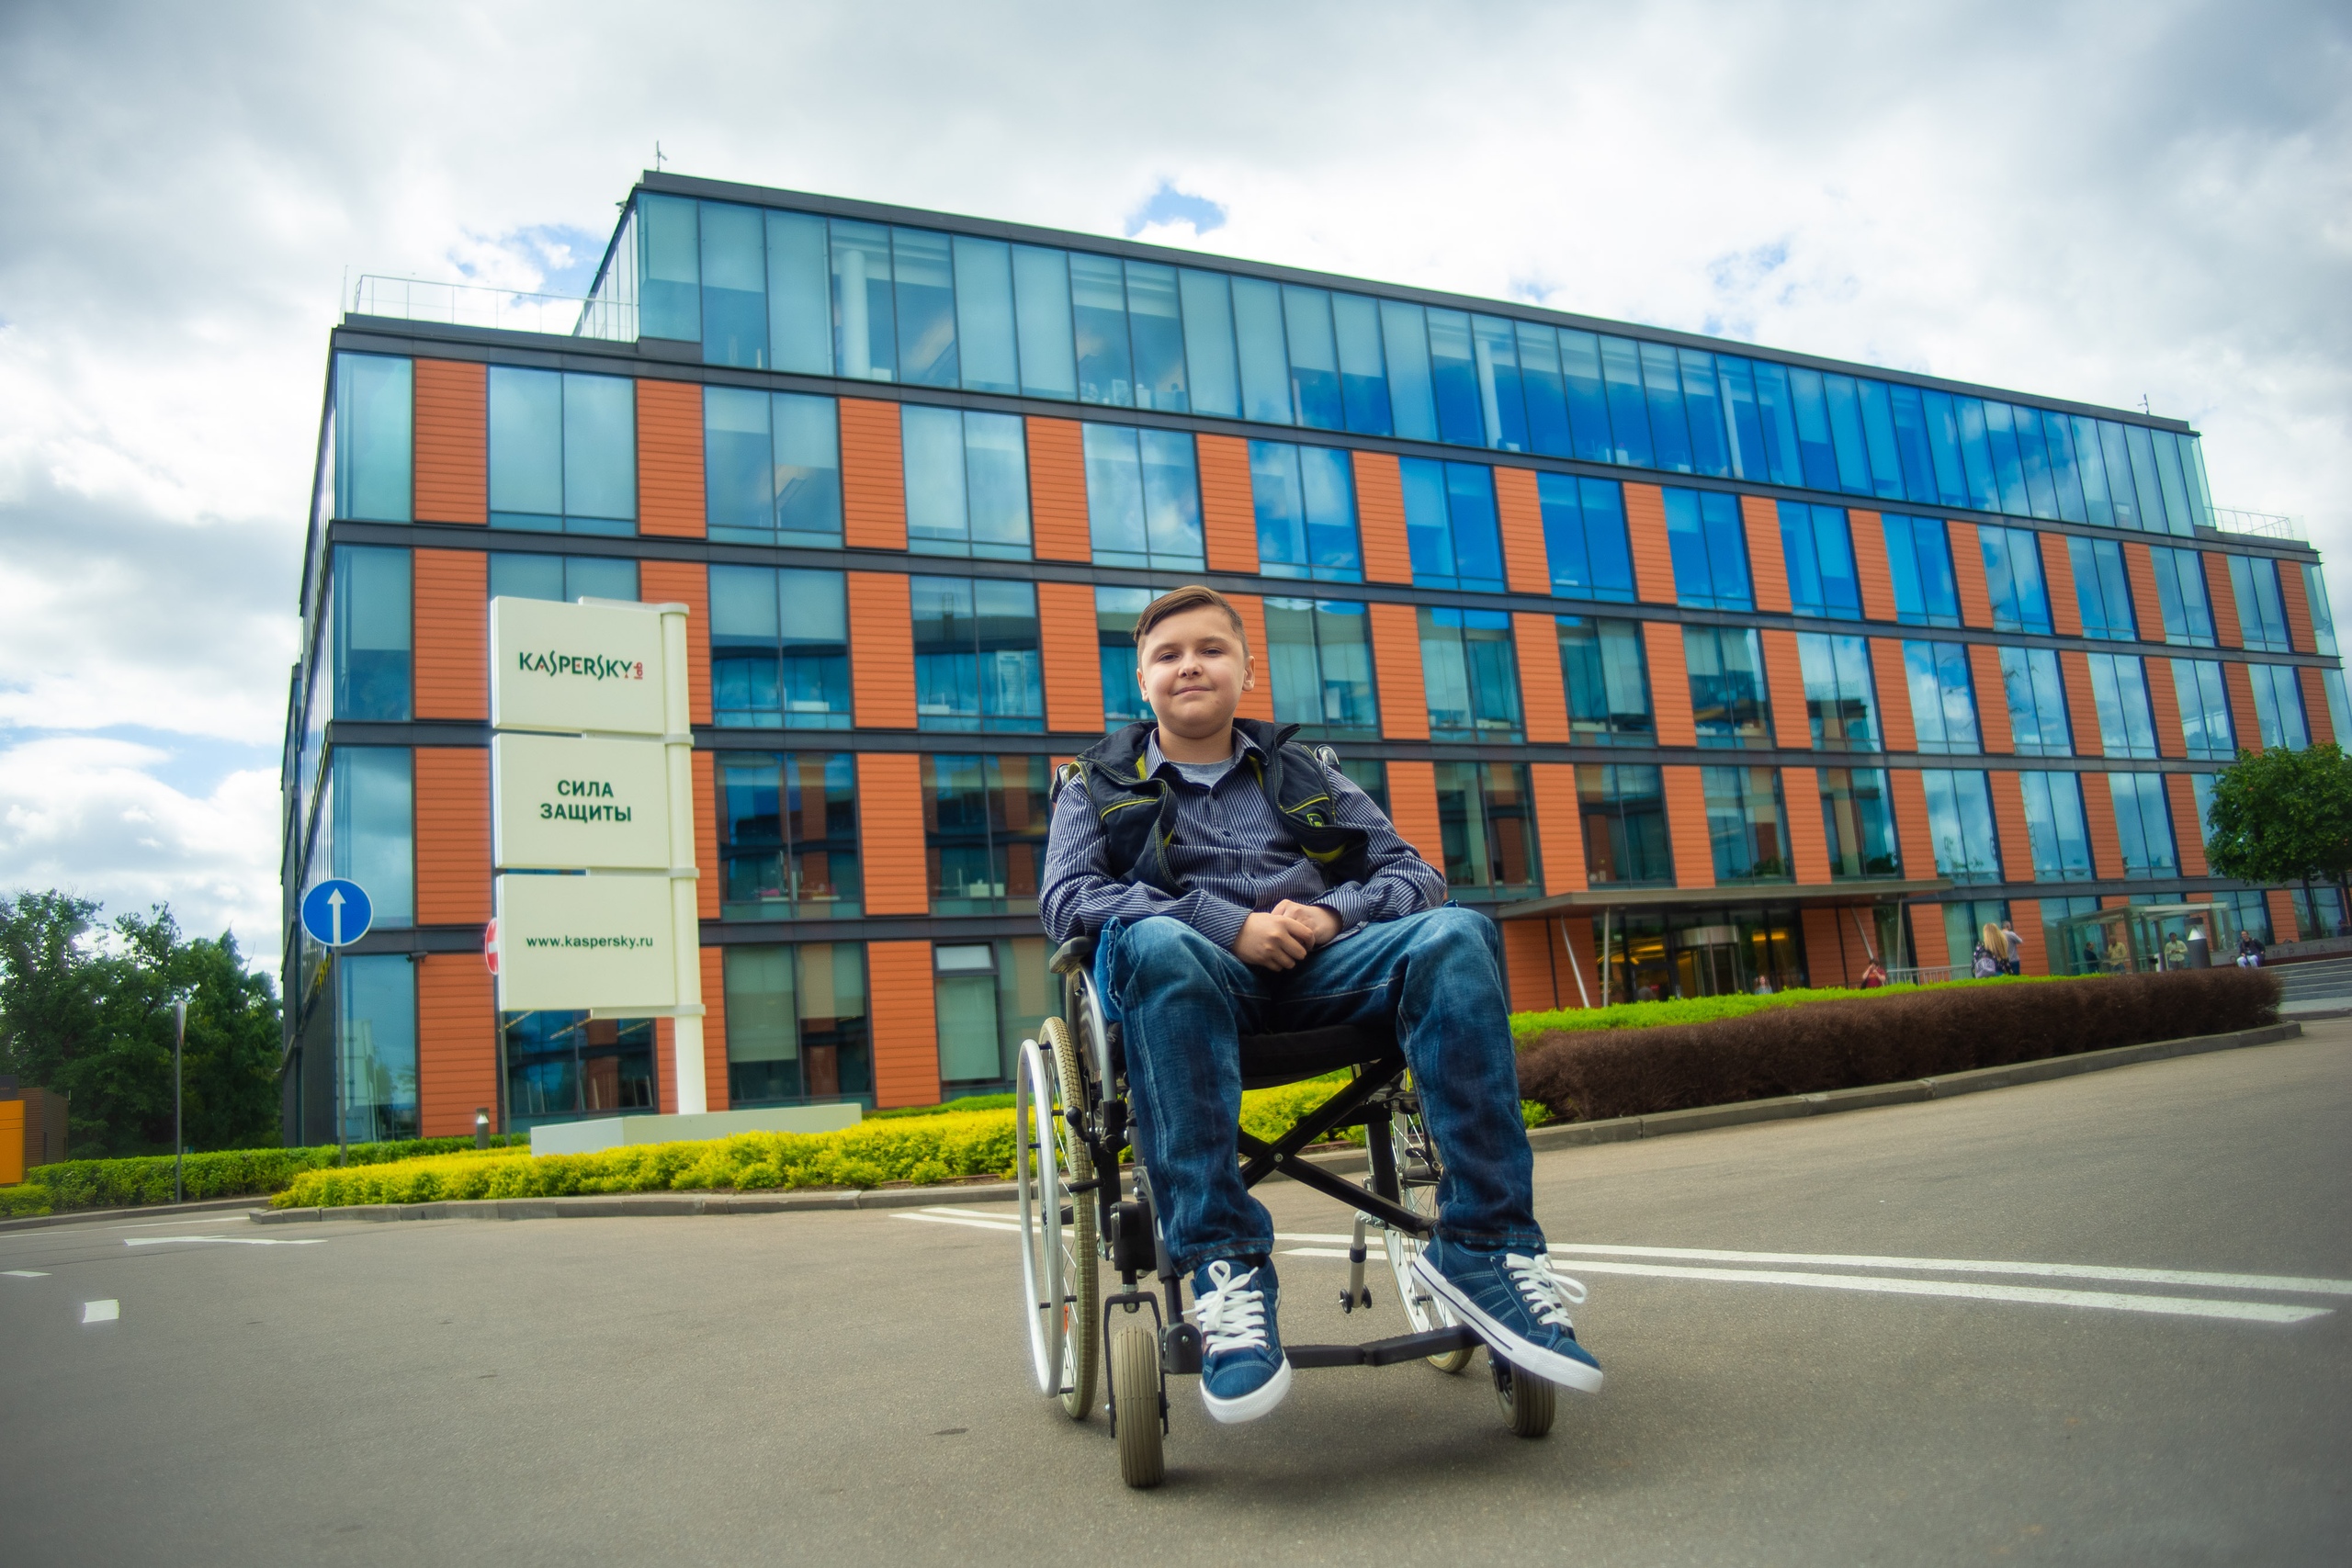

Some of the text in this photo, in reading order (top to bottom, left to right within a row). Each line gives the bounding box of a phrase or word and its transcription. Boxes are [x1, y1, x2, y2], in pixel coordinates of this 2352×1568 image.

[519, 649, 633, 681] KASPERSKY
[633, 661, 643, 681] lab
[557, 779, 614, 798] СИЛА
[540, 802, 632, 824] ЗАЩИТЫ
[526, 934, 653, 950] www.kaspersky.ru
